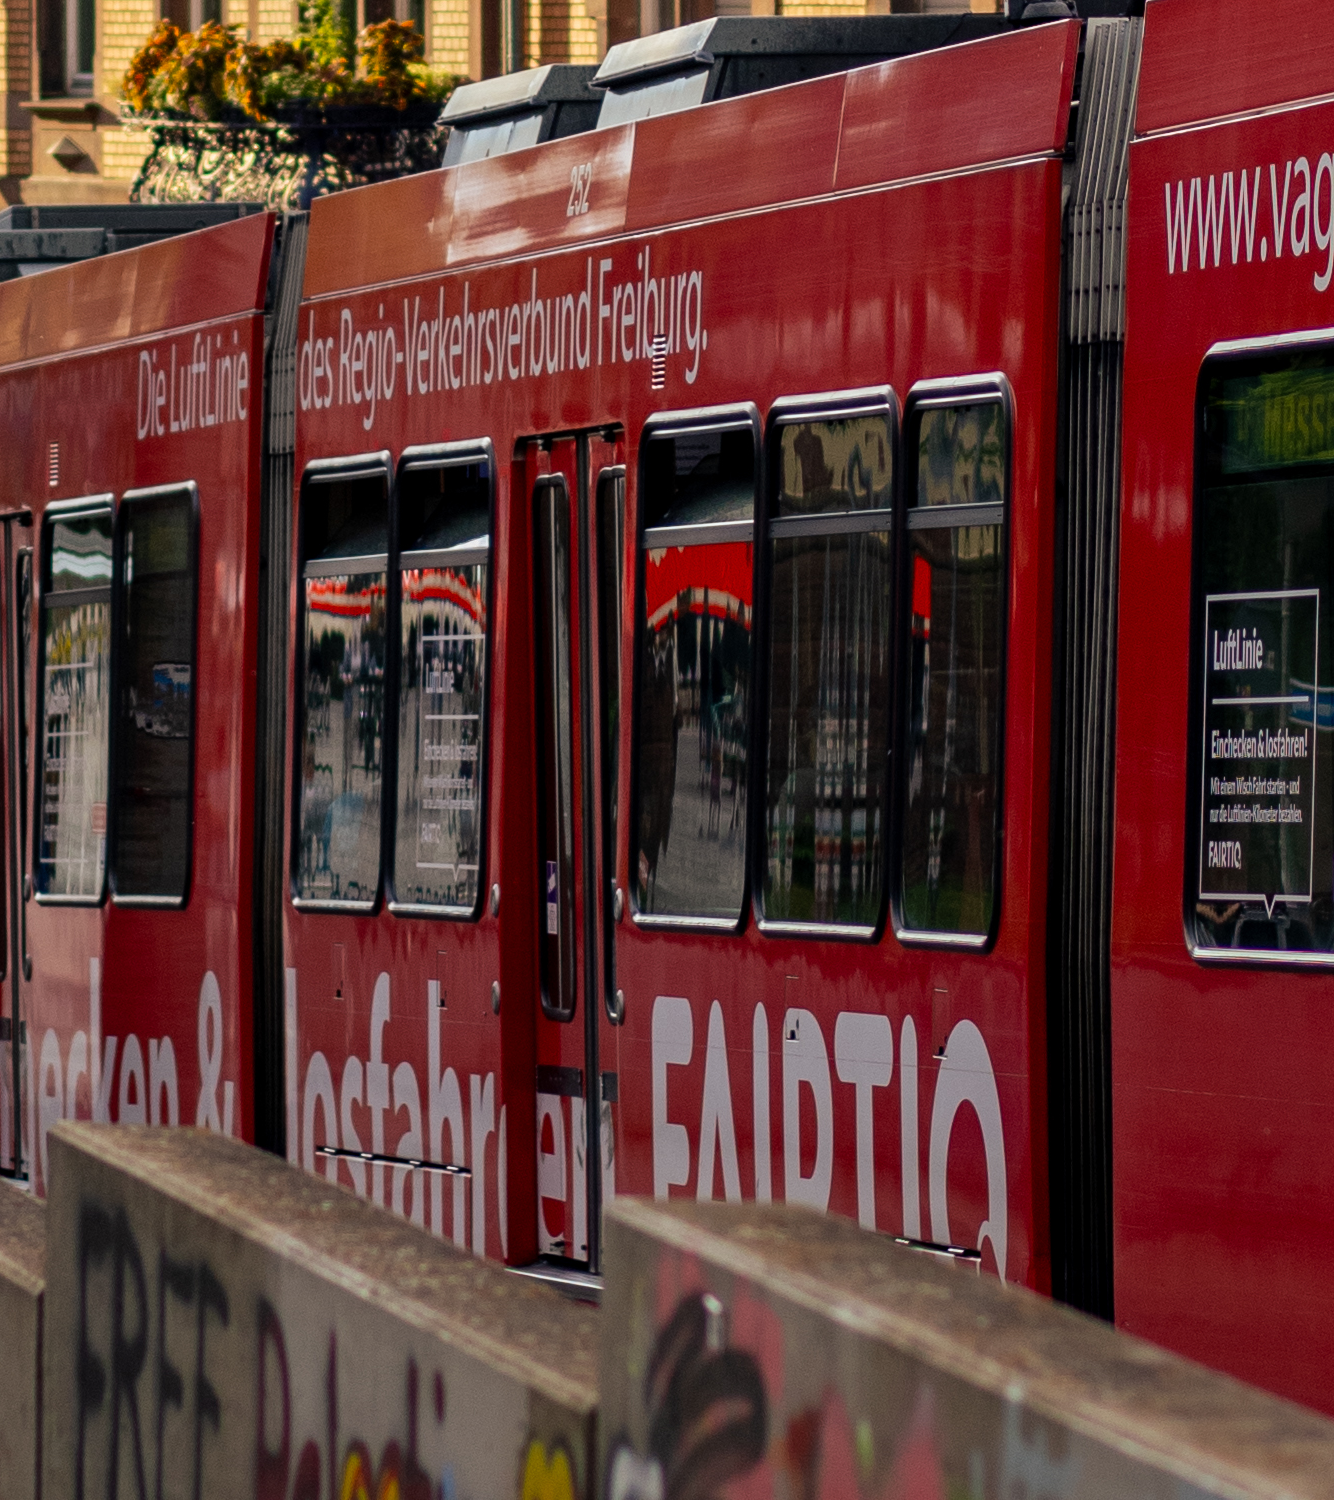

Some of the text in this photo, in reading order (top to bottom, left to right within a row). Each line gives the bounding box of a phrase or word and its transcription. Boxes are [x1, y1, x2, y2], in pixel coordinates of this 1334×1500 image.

[566, 162, 592, 217] 252
[136, 245, 708, 441] Die LuftLinie des Regio-Verkehrsverbund Freiburg.
[1213, 627, 1264, 671] LuftLinie
[1211, 727, 1308, 759] Einchecken & losfahren!
[1208, 840, 1242, 870] FAIRTIQ
